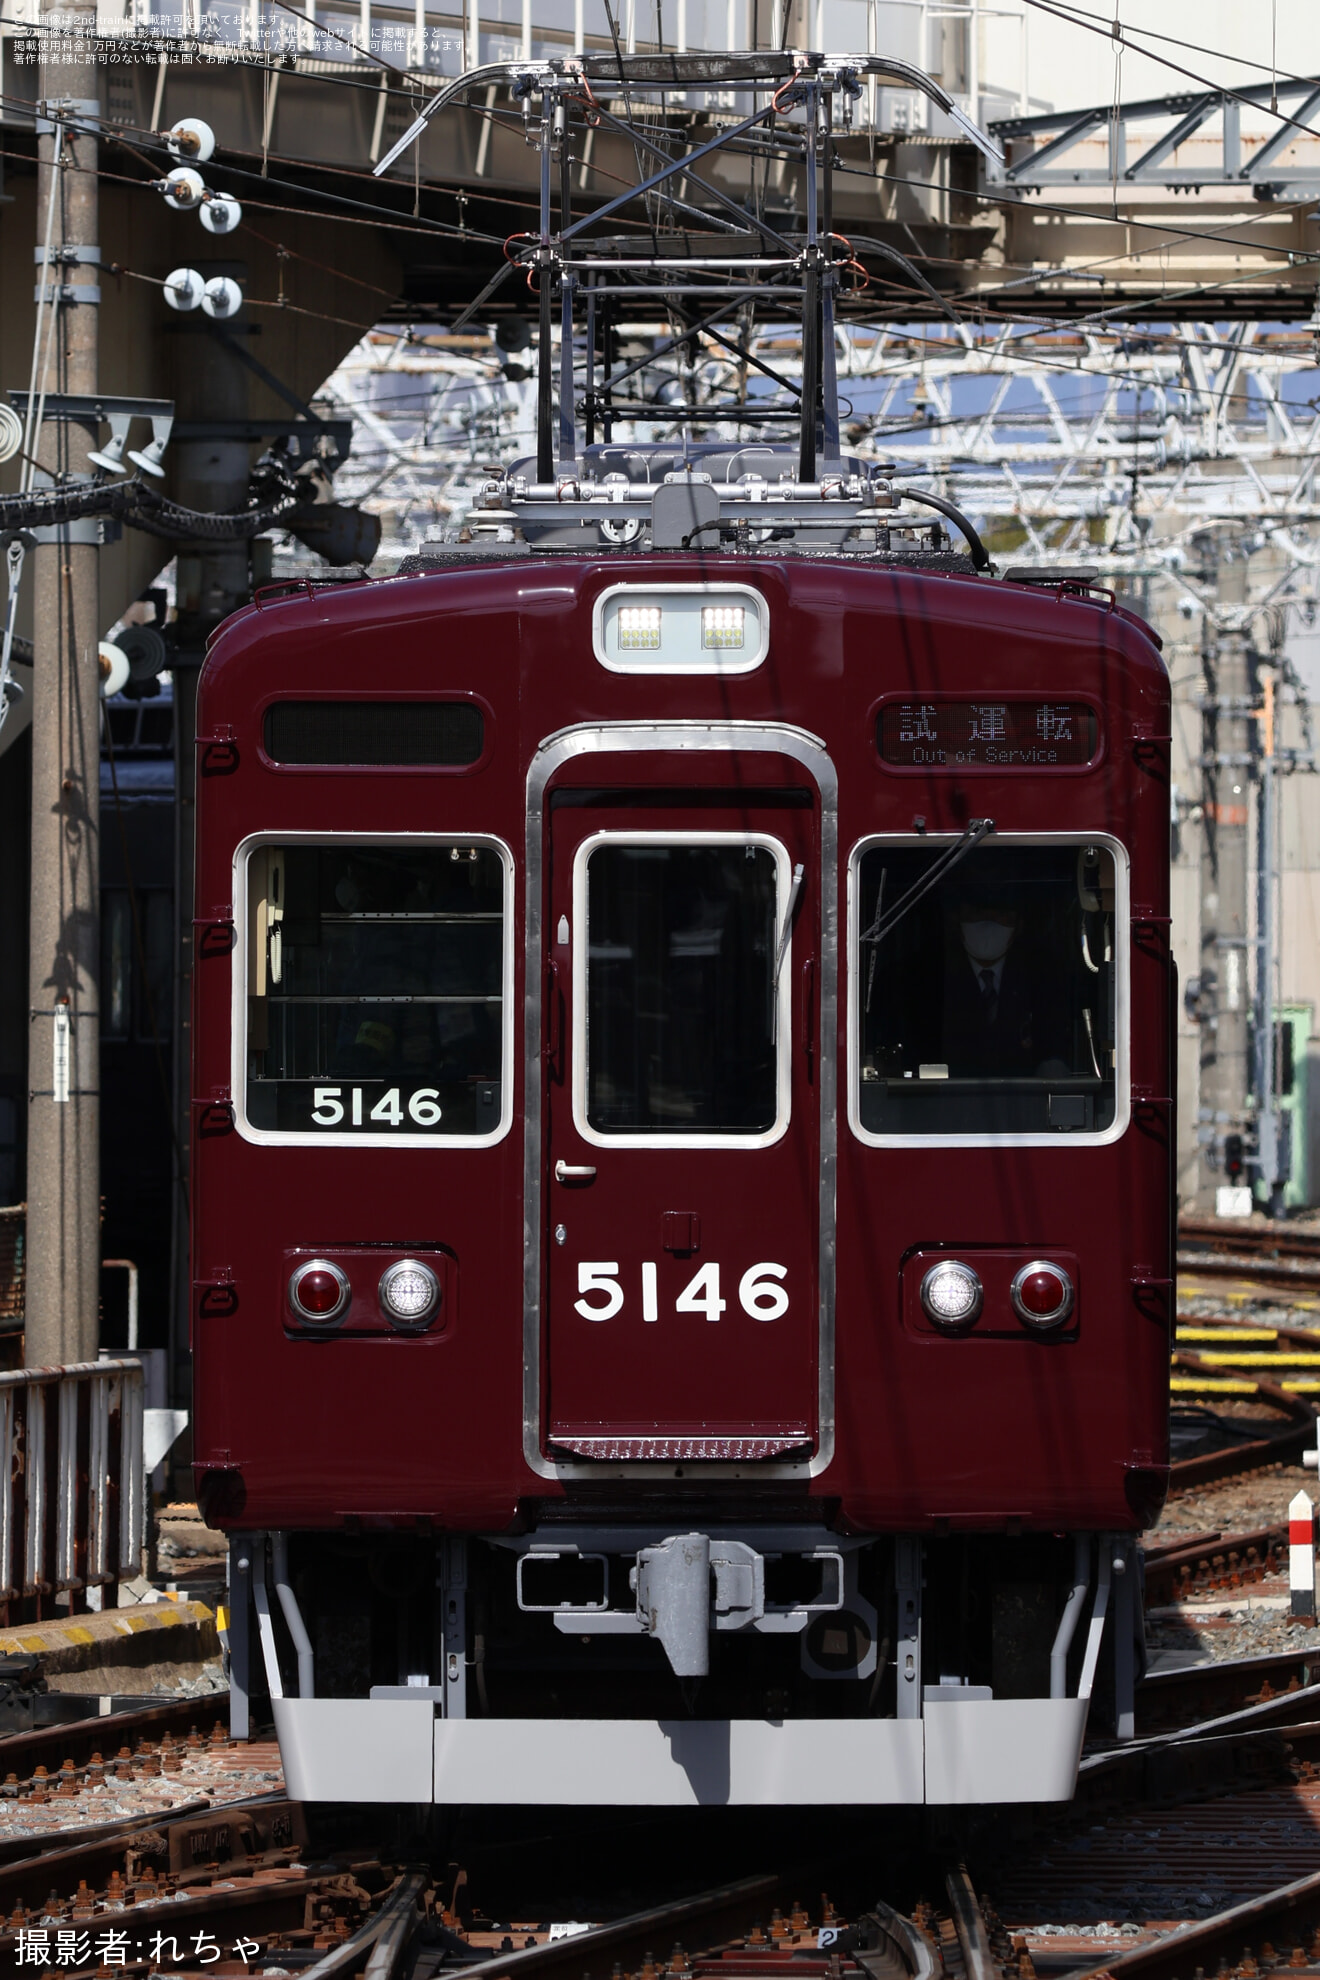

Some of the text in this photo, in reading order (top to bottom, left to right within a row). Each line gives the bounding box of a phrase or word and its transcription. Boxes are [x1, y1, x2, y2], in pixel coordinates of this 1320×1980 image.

[900, 705, 1072, 741] 試運転
[913, 746, 1057, 762] Out of Service
[311, 1087, 442, 1126] 5146
[574, 1262, 789, 1322] 5146
[822, 1930, 834, 1947] 2
